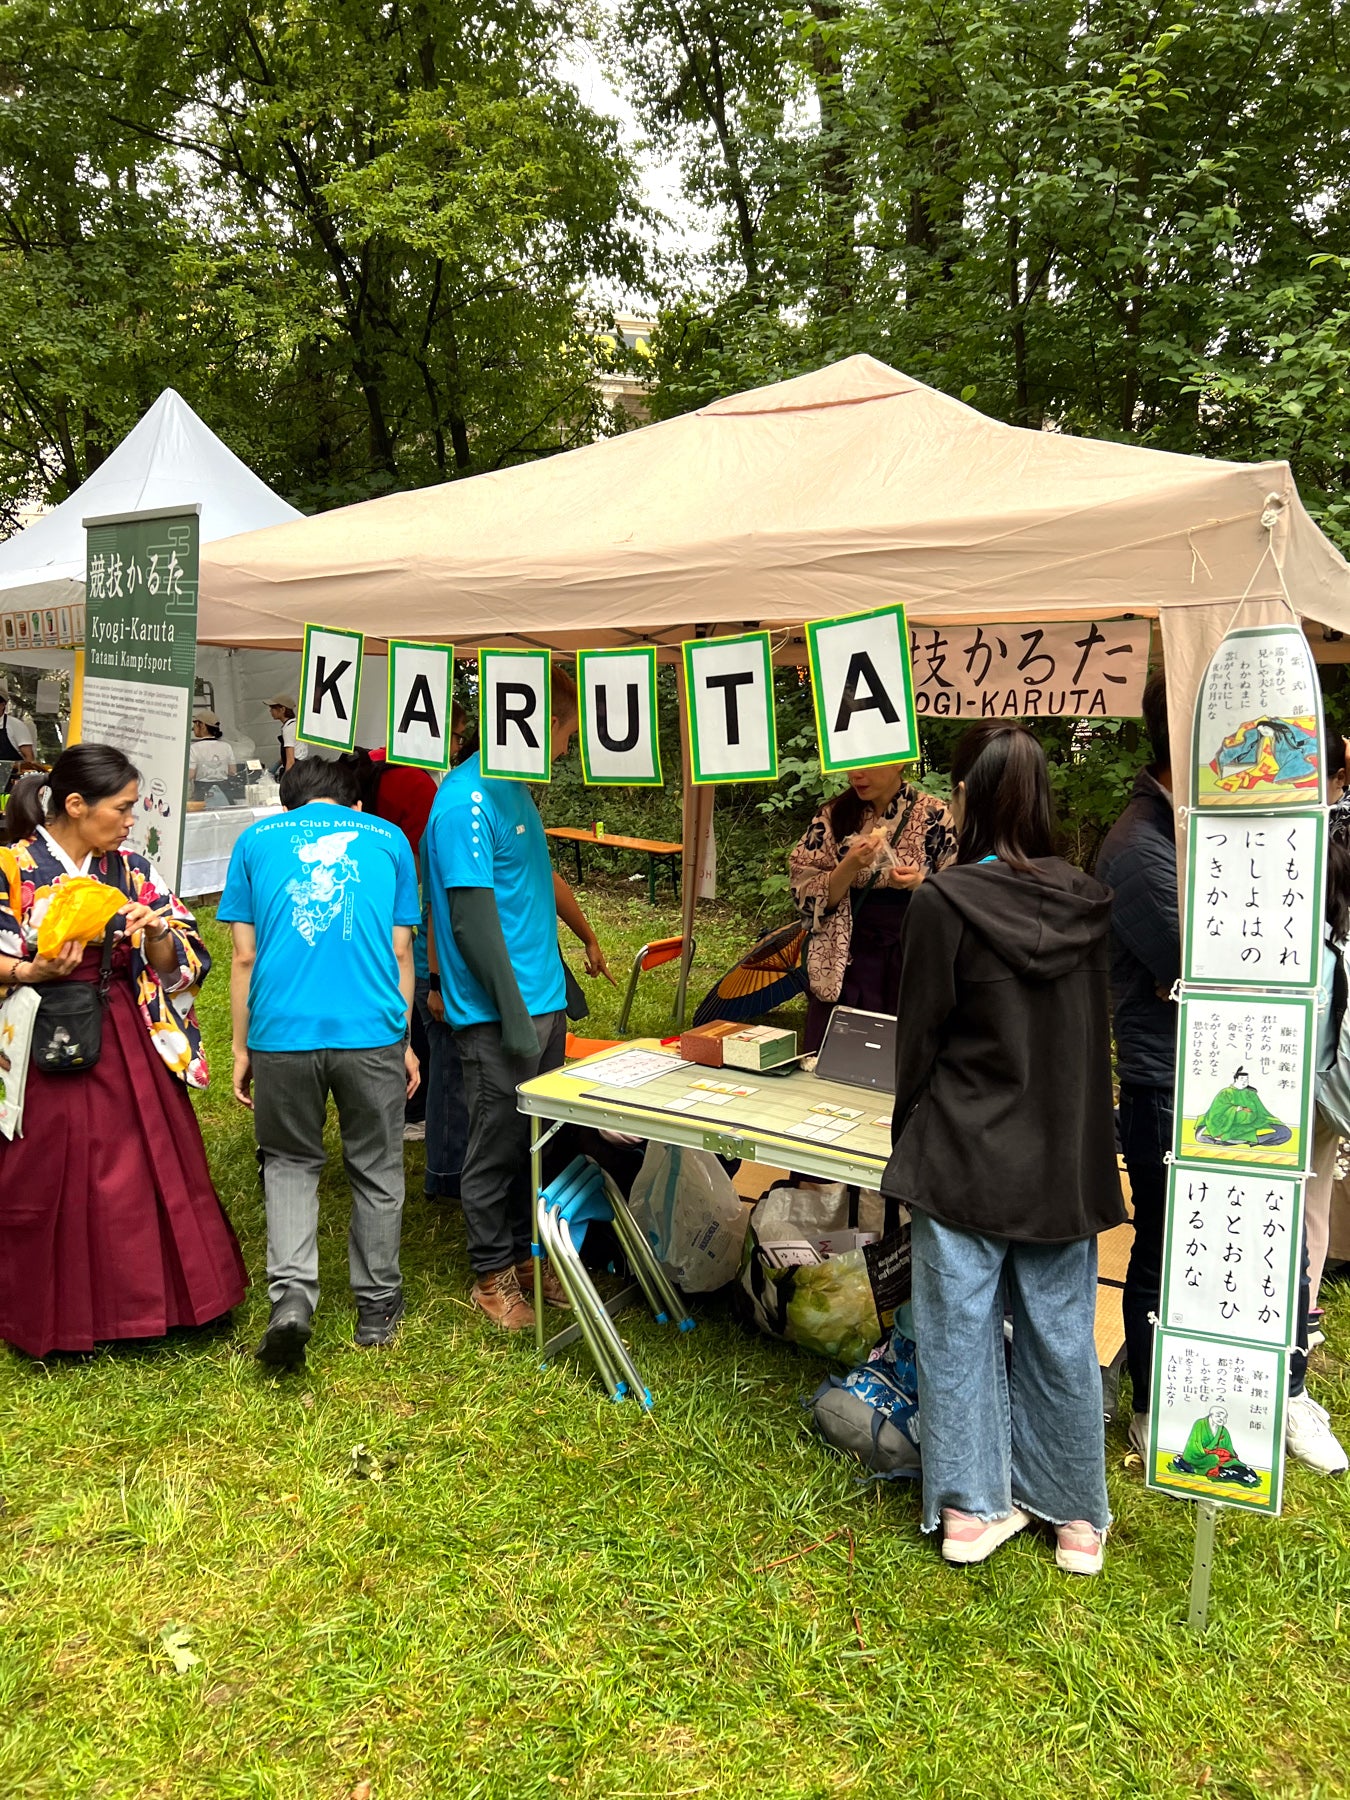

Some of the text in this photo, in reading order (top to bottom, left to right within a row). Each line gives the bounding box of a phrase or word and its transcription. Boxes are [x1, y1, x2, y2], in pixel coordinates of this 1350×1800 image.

[89, 550, 184, 599] 競技かるた
[91, 616, 175, 644] Kyogi-Karuta
[91, 649, 172, 673] Tatami Kampfsport
[255, 819, 392, 839] Karuta Club München
[1206, 834, 1228, 936] つきかな
[1241, 831, 1265, 963] にしよはの
[1280, 828, 1304, 966] くもかくれ
[1192, 1021, 1203, 1075] 思ひけるかな
[1209, 1013, 1220, 1076] ながくもがなと
[1244, 1015, 1255, 1060] からざりし
[1185, 1182, 1208, 1287] けるかな
[1219, 1185, 1245, 1319] なとおもひ
[1258, 1190, 1285, 1323] なかくもか
